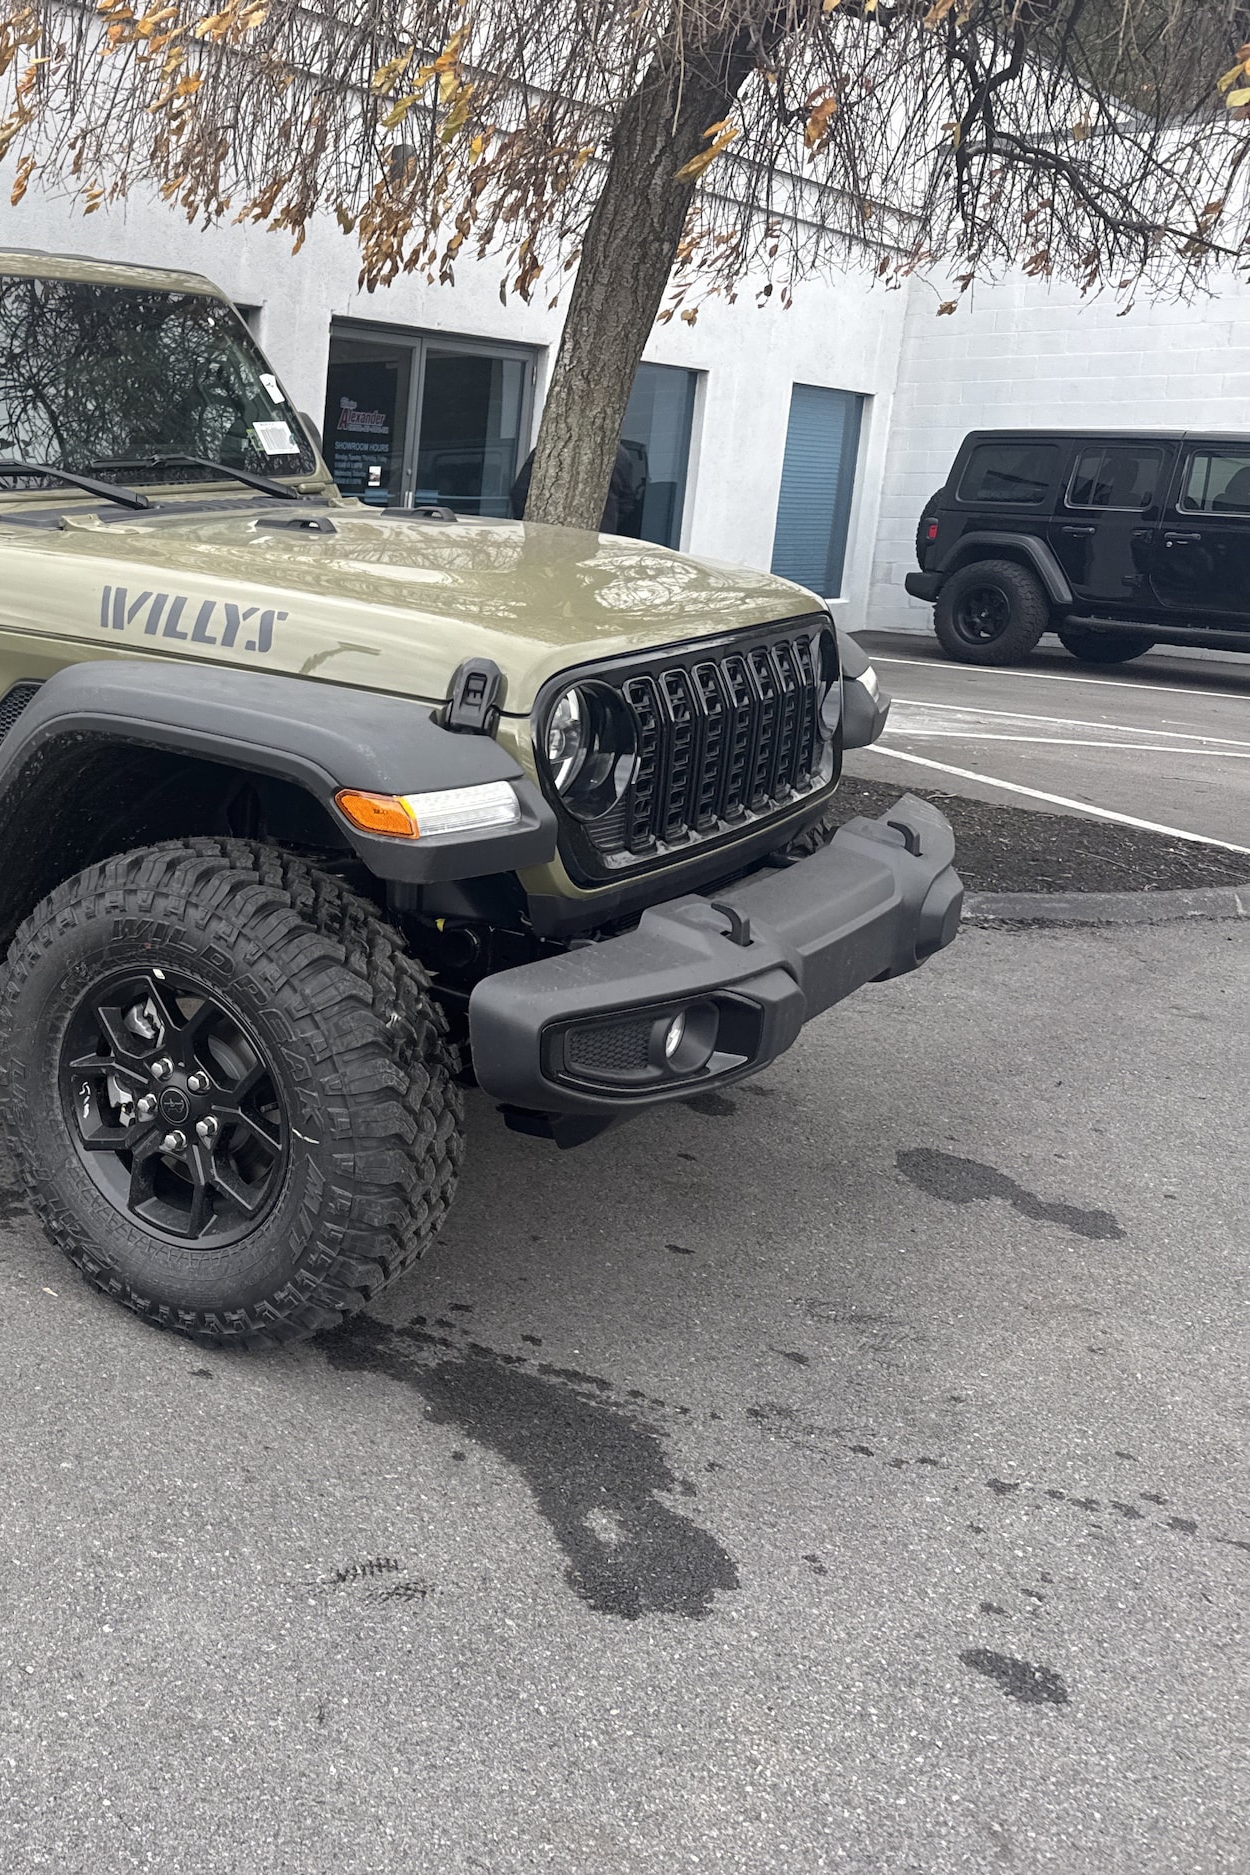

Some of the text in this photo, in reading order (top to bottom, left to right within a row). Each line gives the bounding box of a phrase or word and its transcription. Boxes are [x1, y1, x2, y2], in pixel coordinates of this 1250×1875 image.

[337, 408, 386, 430] Alexander
[334, 441, 389, 452] SHOWROOM HOURS
[101, 586, 288, 653] WILLYS
[111, 917, 327, 1132] WILDPEAK
